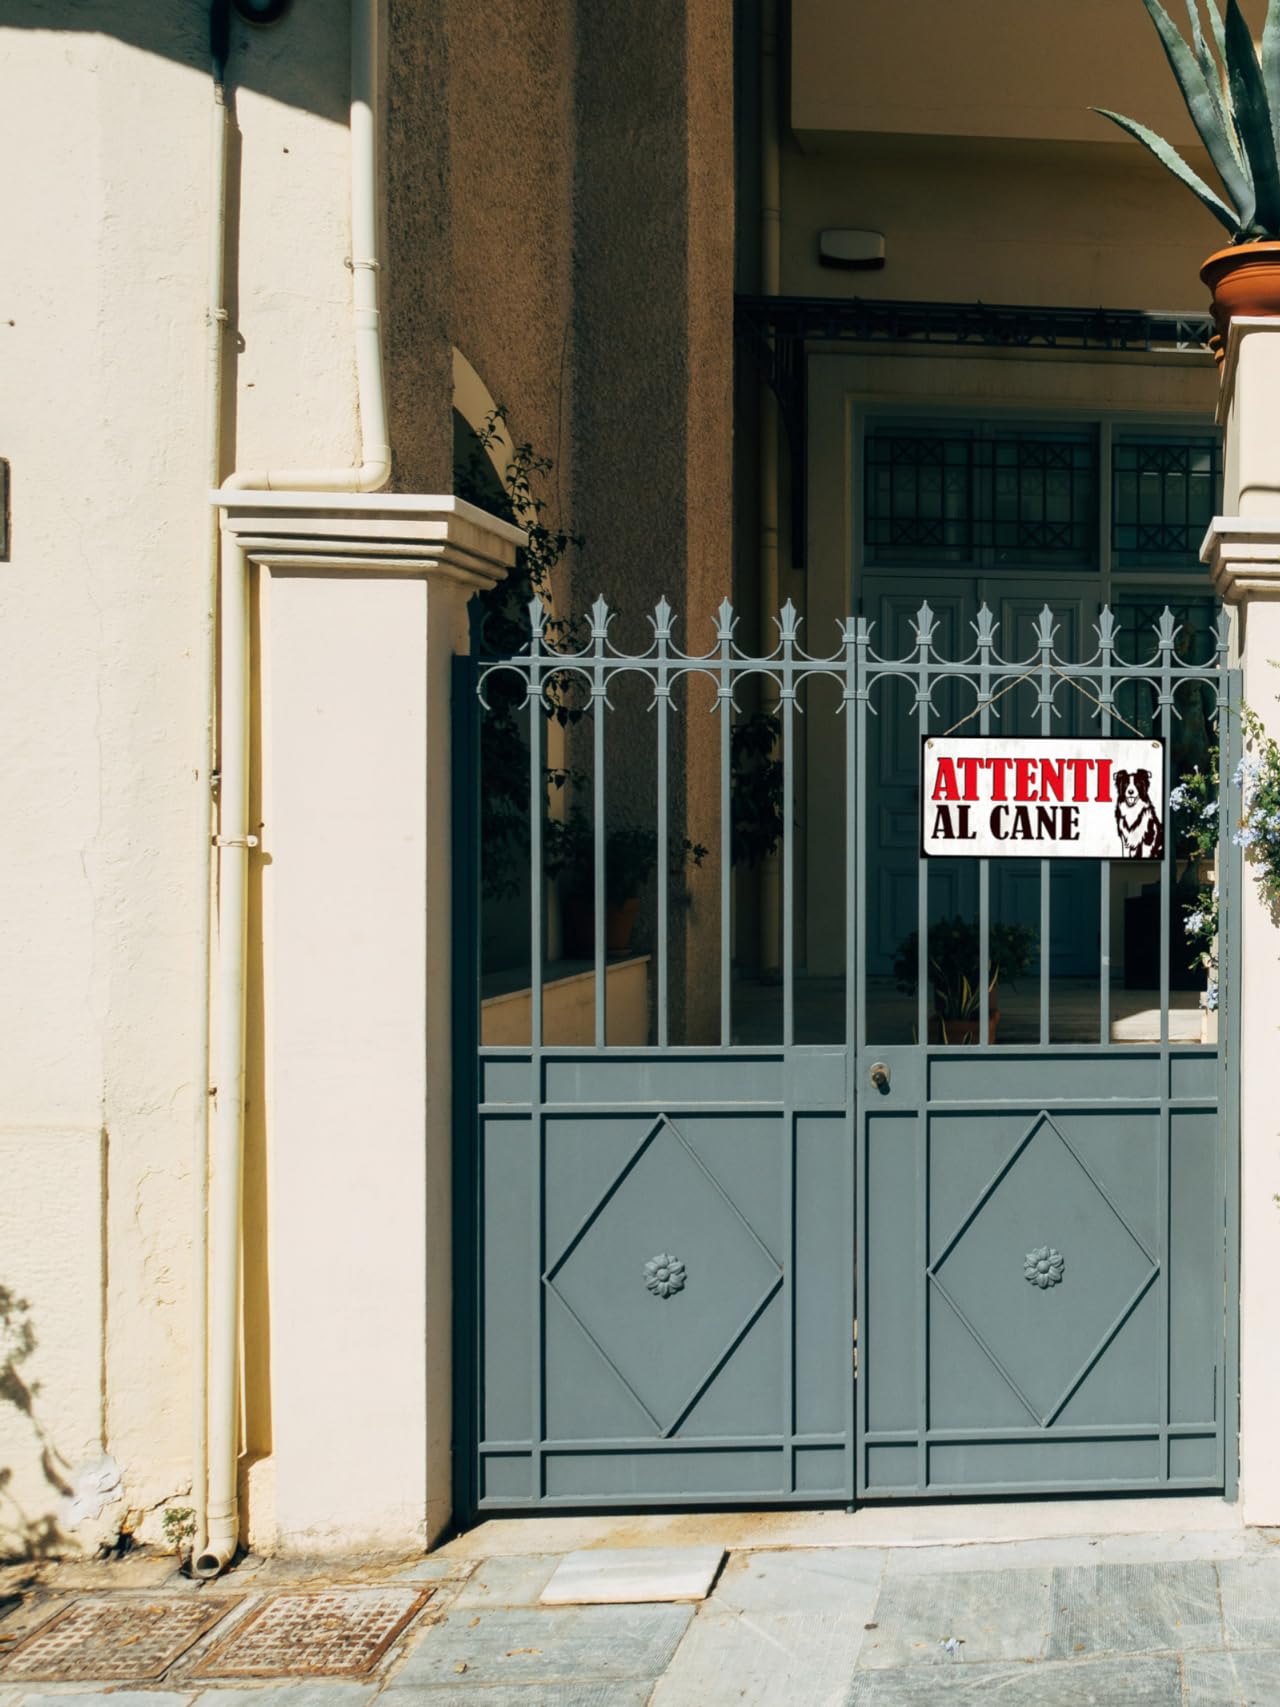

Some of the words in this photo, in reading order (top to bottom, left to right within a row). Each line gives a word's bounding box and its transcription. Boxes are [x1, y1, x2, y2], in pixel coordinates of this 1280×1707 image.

[931, 757, 1113, 802] ATTENTI
[931, 805, 977, 840] AL
[989, 805, 1081, 841] CANE
